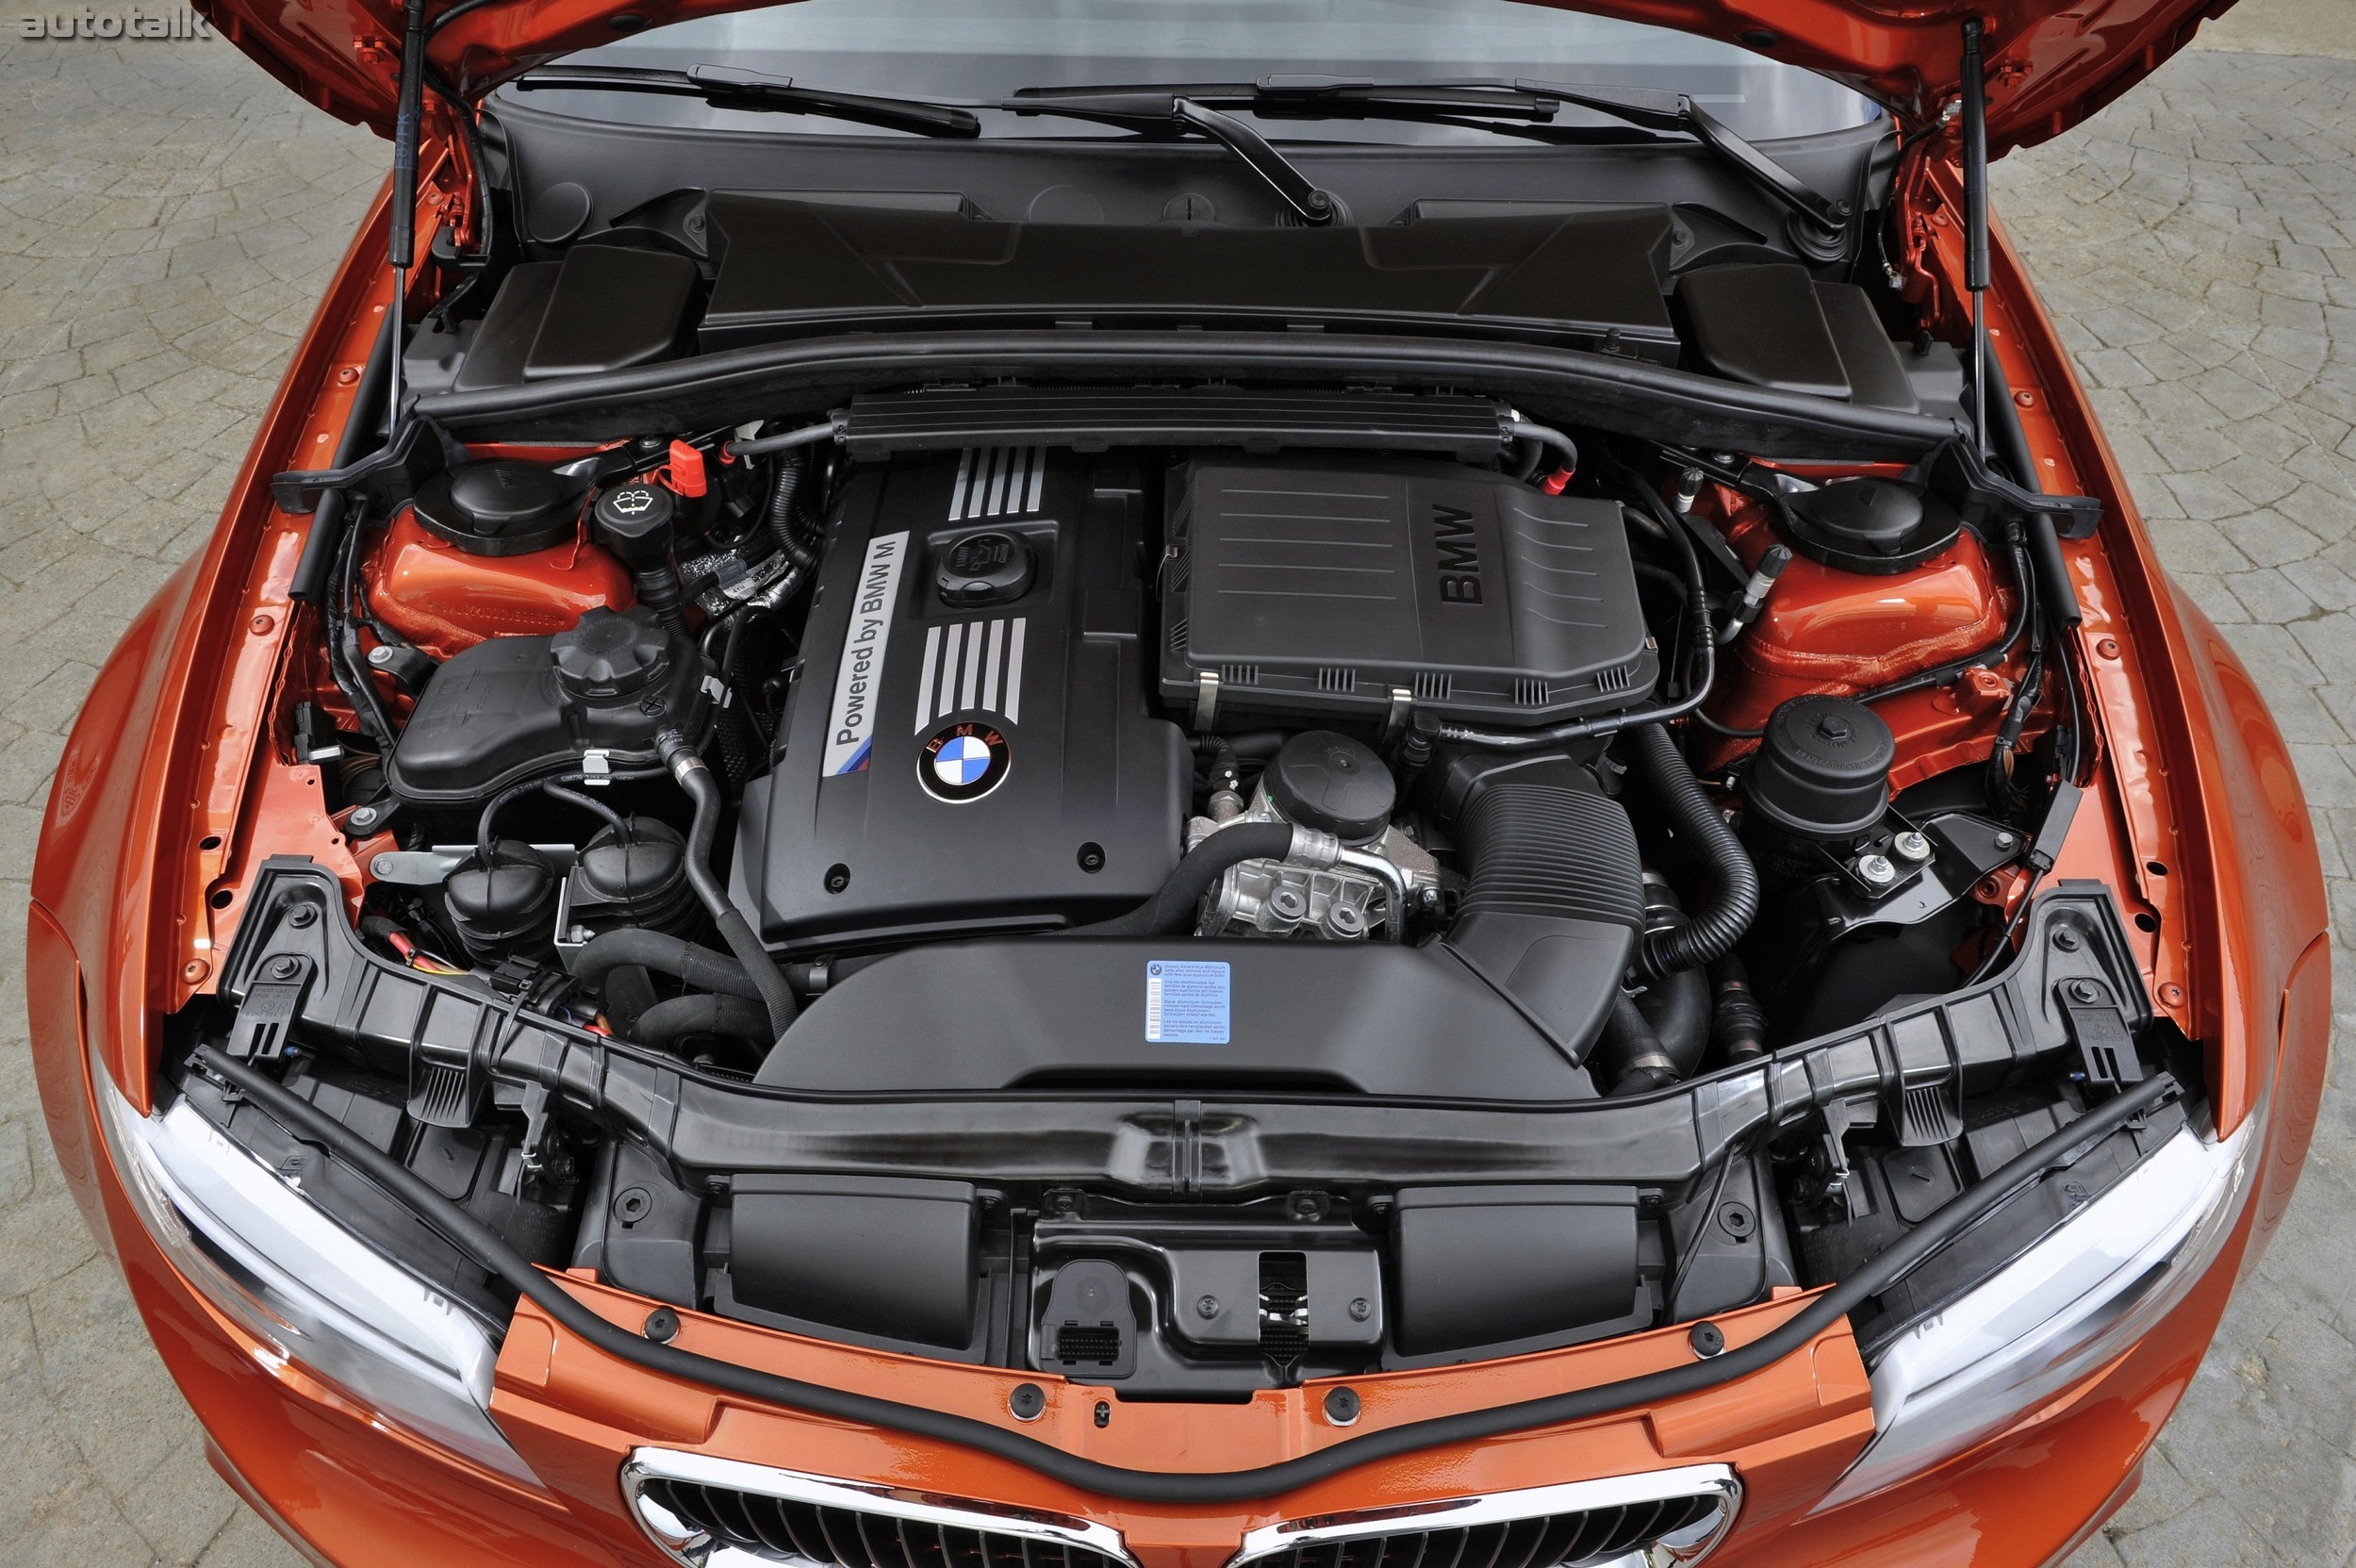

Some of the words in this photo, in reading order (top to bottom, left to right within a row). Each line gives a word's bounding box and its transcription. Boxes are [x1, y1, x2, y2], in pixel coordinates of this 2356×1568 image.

[873, 541, 897, 559] M
[1433, 503, 1483, 604] BMW
[860, 564, 891, 614] BMW
[853, 619, 884, 644] by
[836, 647, 874, 745] Powered
[926, 724, 1003, 753] BMW
